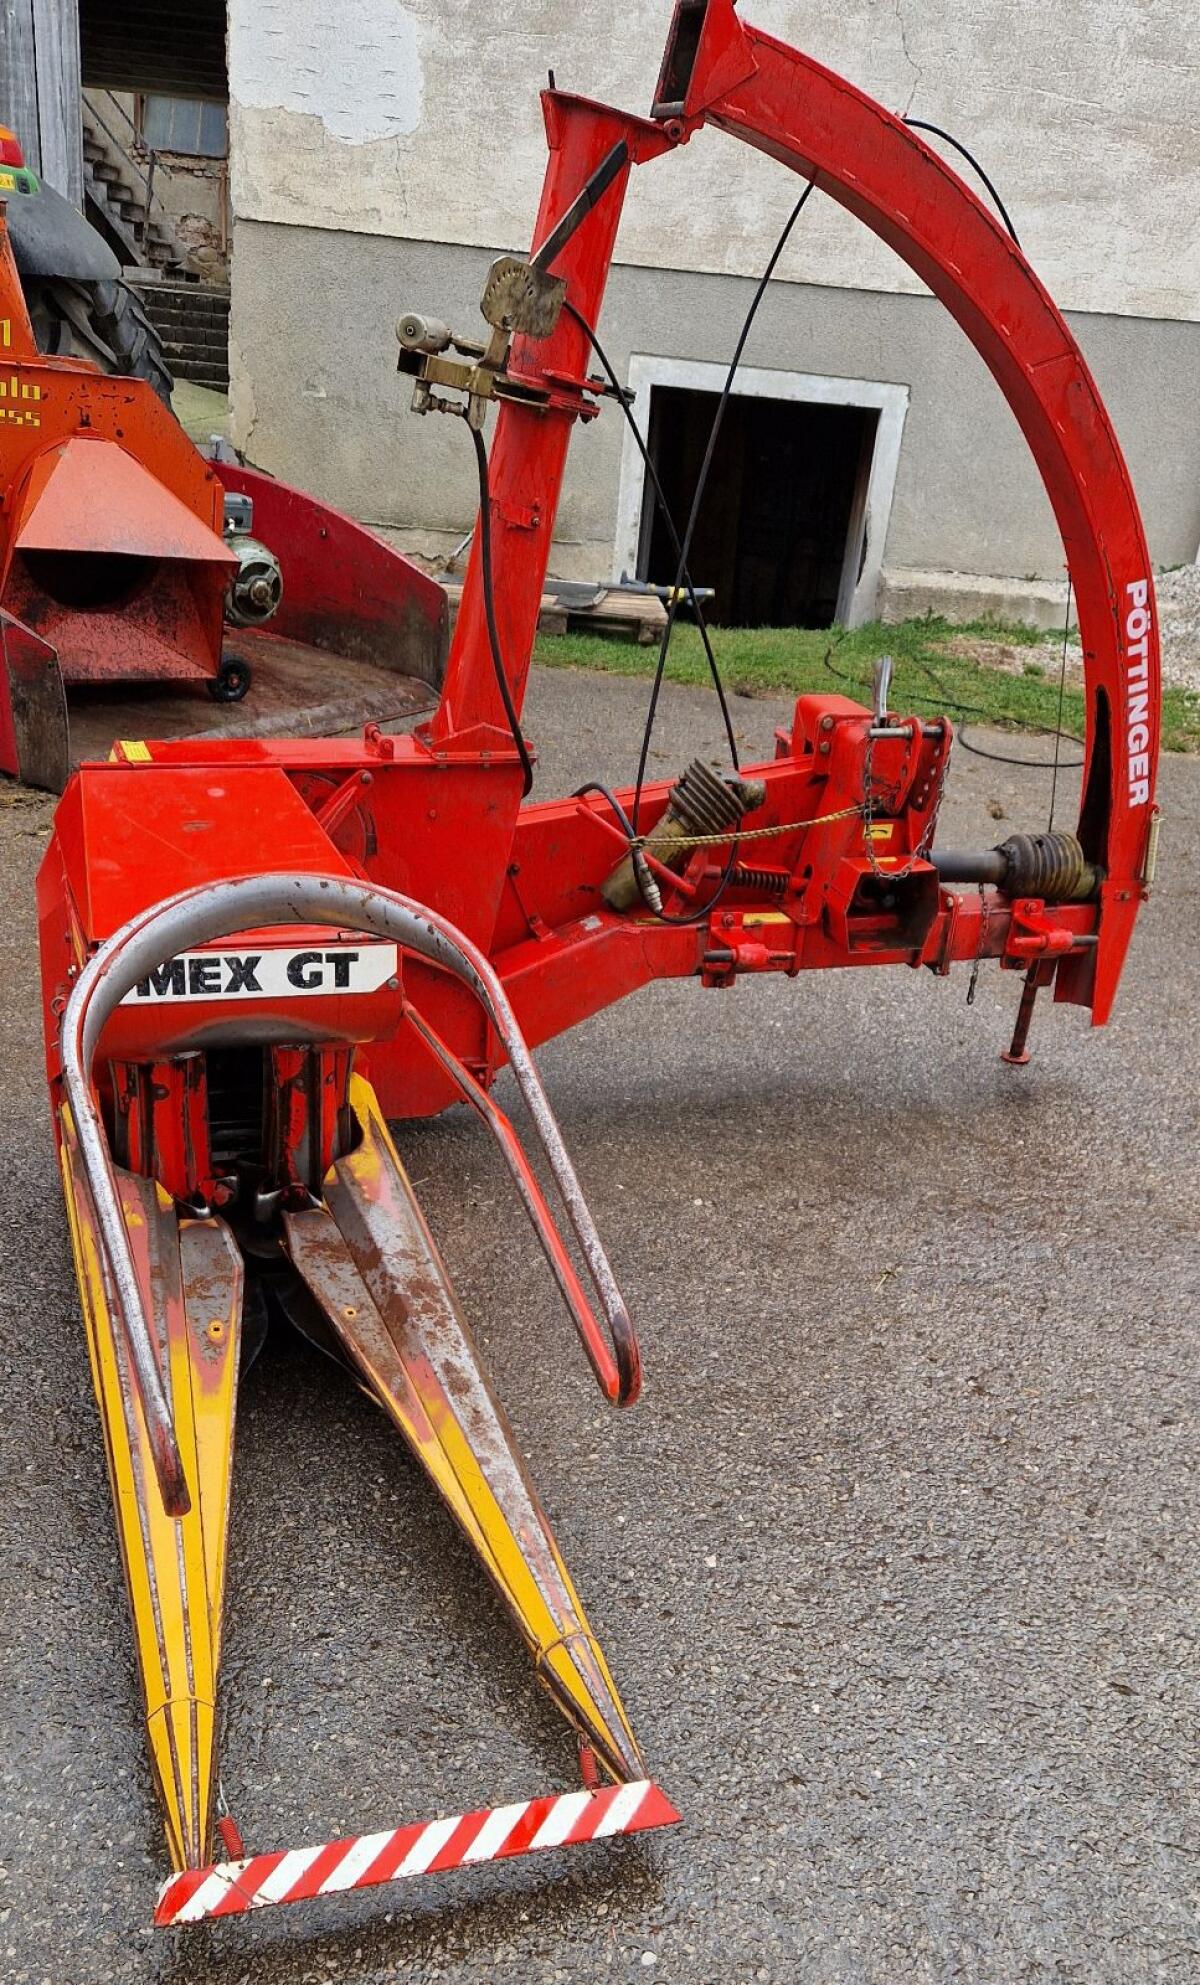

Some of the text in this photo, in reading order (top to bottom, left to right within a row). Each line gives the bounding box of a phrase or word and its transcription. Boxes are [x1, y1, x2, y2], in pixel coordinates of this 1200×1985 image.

[1126, 579, 1151, 809] PÖTTINGER
[136, 951, 359, 997] MEX GT
